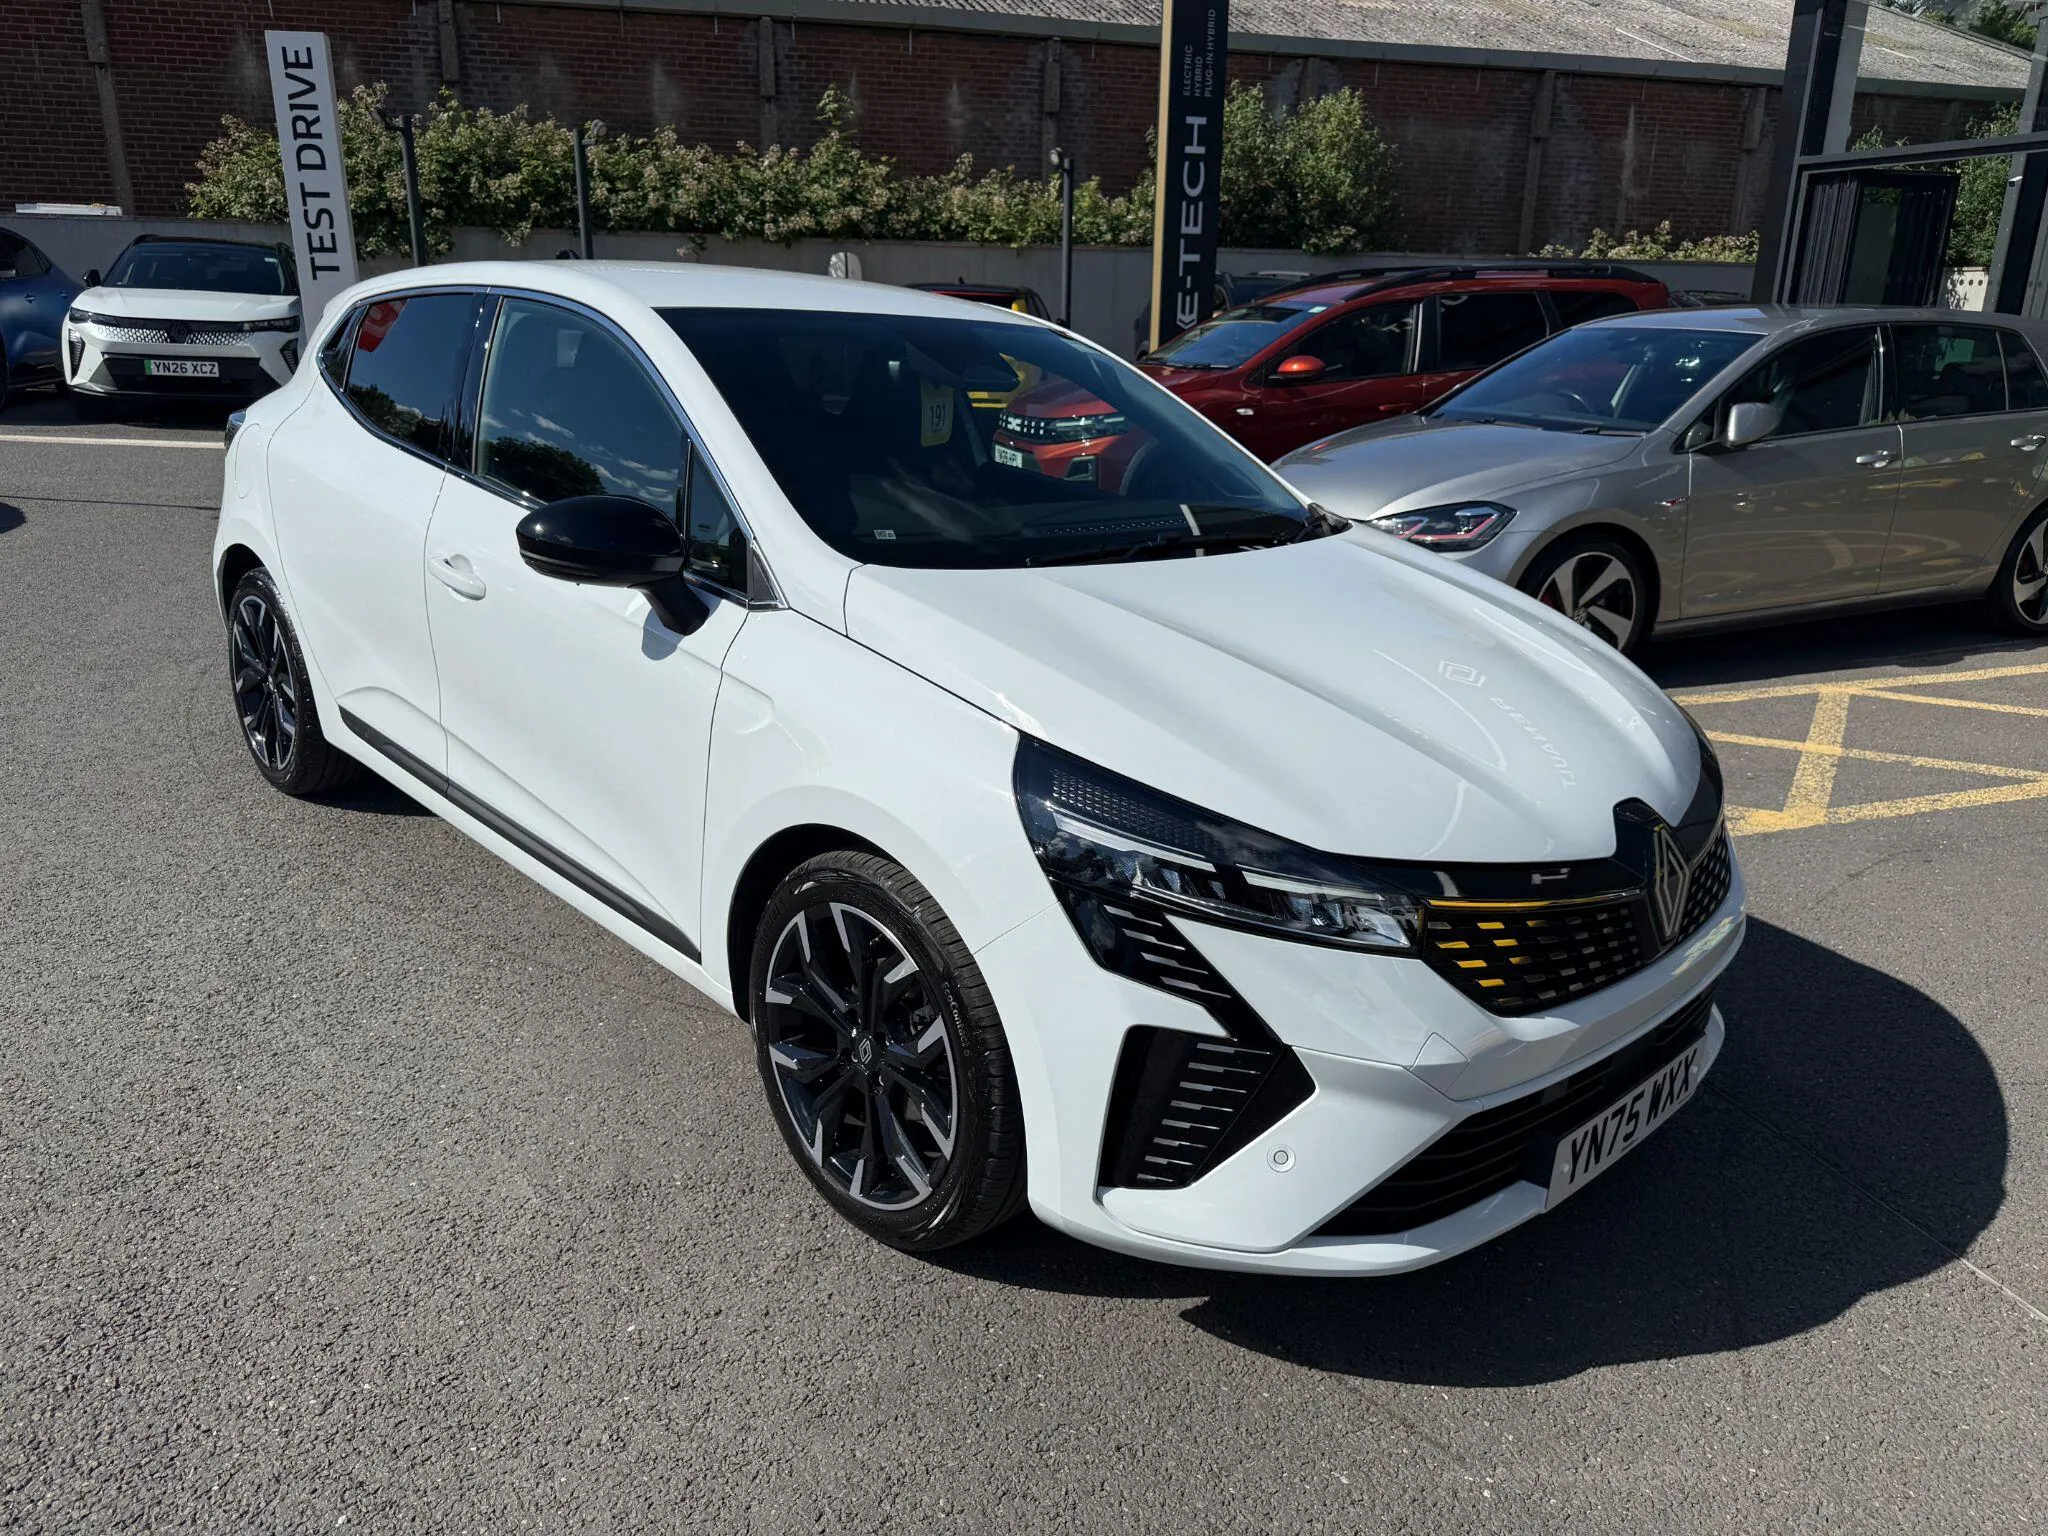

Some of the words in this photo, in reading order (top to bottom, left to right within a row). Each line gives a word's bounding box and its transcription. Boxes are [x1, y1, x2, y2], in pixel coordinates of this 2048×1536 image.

[1207, 9, 1216, 50] HYBRID
[1183, 44, 1193, 96] ELECTRIC
[1194, 56, 1203, 97] HYBRID
[1204, 52, 1214, 97] PLUG-IN
[281, 46, 327, 173] DRIVE
[300, 182, 340, 281] TEST
[1176, 116, 1208, 330] E-TECH
[153, 361, 188, 374] YN26
[191, 363, 217, 375] XCZ
[1568, 1089, 1646, 1185] YN75
[1646, 1047, 1698, 1126] WXX
